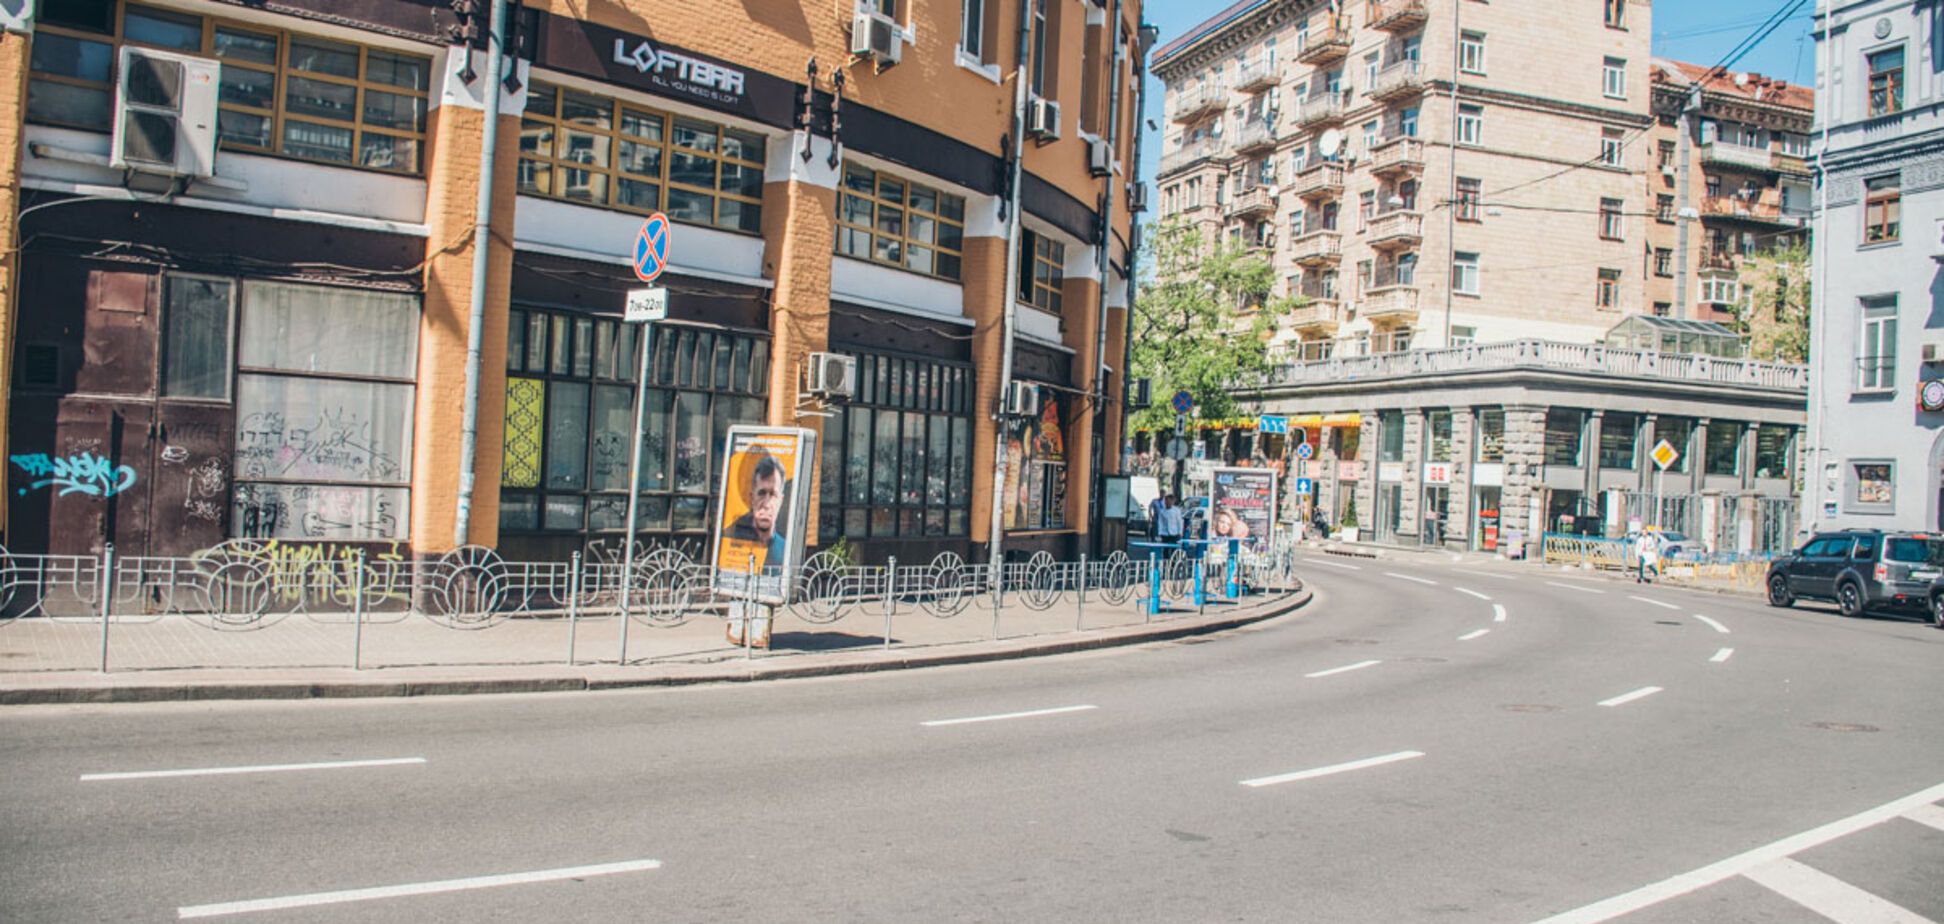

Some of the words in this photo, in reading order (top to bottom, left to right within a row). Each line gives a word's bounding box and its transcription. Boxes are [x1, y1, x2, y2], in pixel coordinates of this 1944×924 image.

[614, 38, 745, 95] LOFTBAR
[652, 75, 669, 87] ALL
[671, 80, 688, 92] YOU
[688, 85, 710, 98] NEED
[719, 94, 739, 105] LOFT
